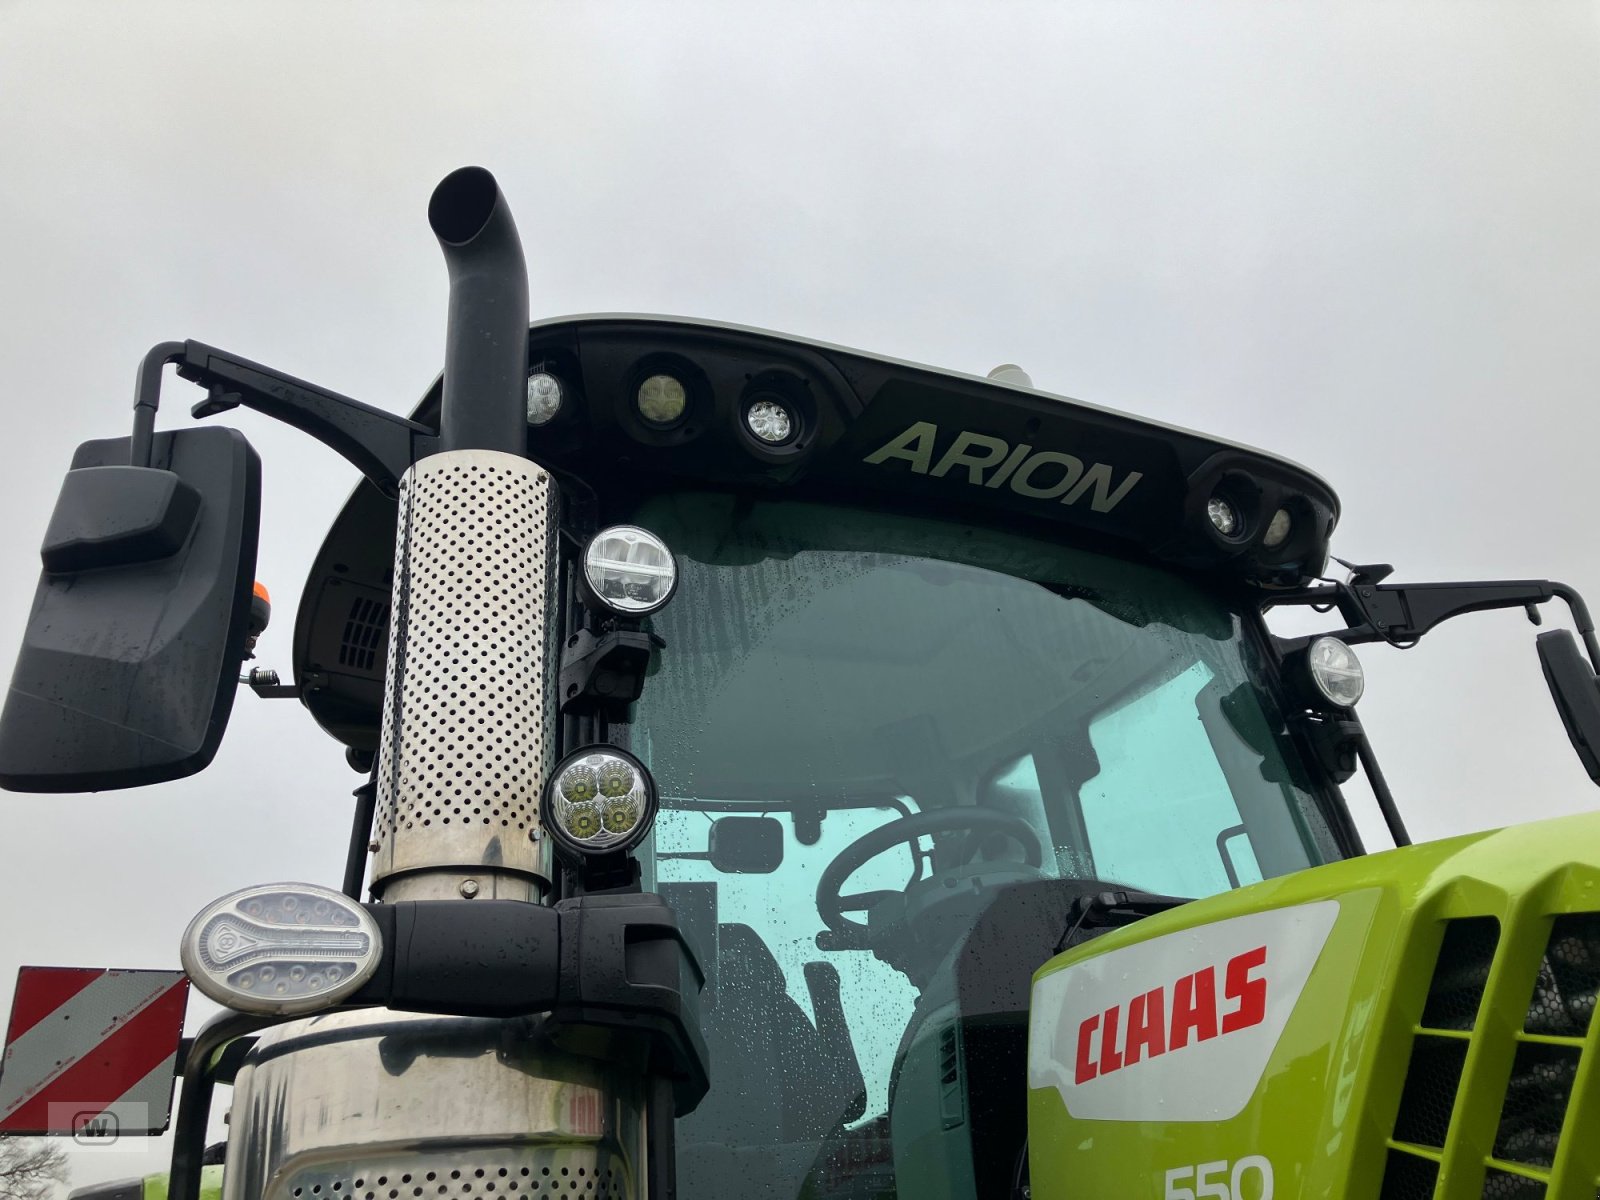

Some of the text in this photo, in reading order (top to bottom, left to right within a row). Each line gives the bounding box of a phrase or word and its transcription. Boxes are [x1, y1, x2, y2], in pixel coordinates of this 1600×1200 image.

[863, 421, 1143, 513] ARION
[1075, 945, 1267, 1086] CLAAS
[1165, 1155, 1274, 1200] 550
